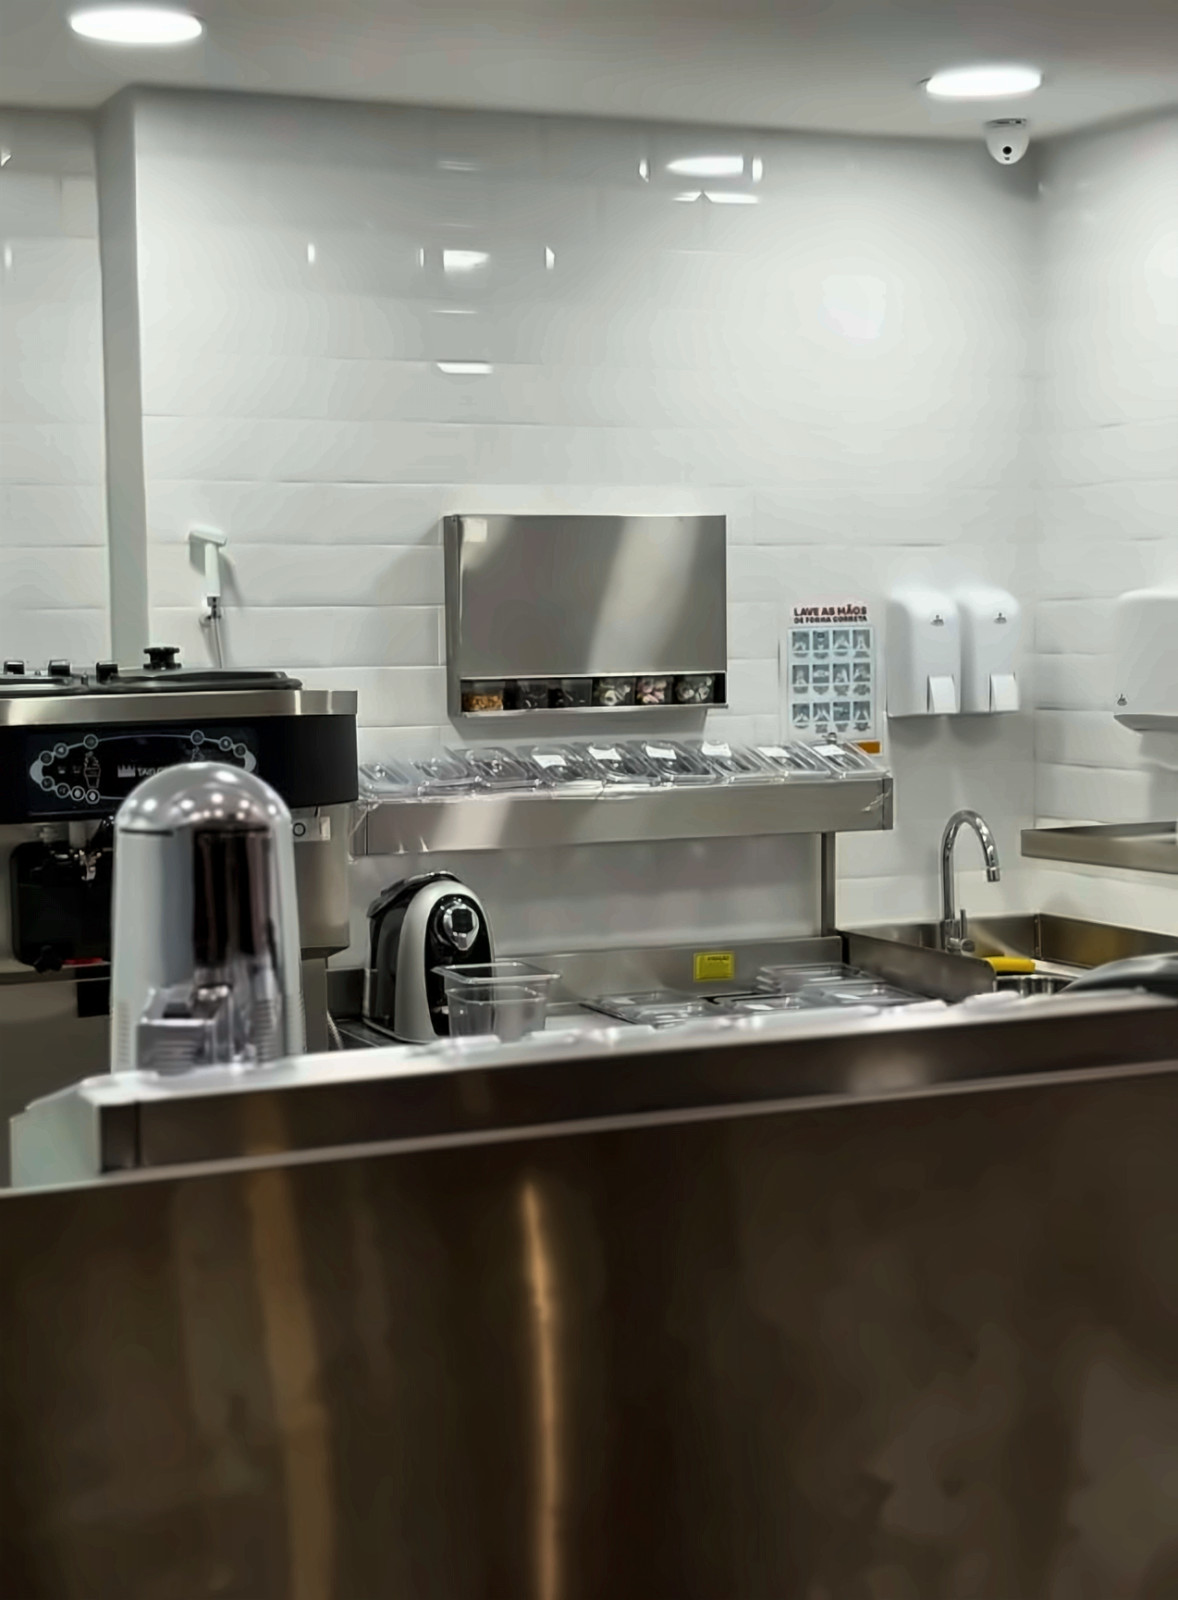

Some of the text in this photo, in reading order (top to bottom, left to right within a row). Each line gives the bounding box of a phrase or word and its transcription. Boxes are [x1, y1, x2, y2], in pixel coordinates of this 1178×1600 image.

[793, 603, 867, 617] LAVE AS MÃOS
[793, 616, 804, 624] DE
